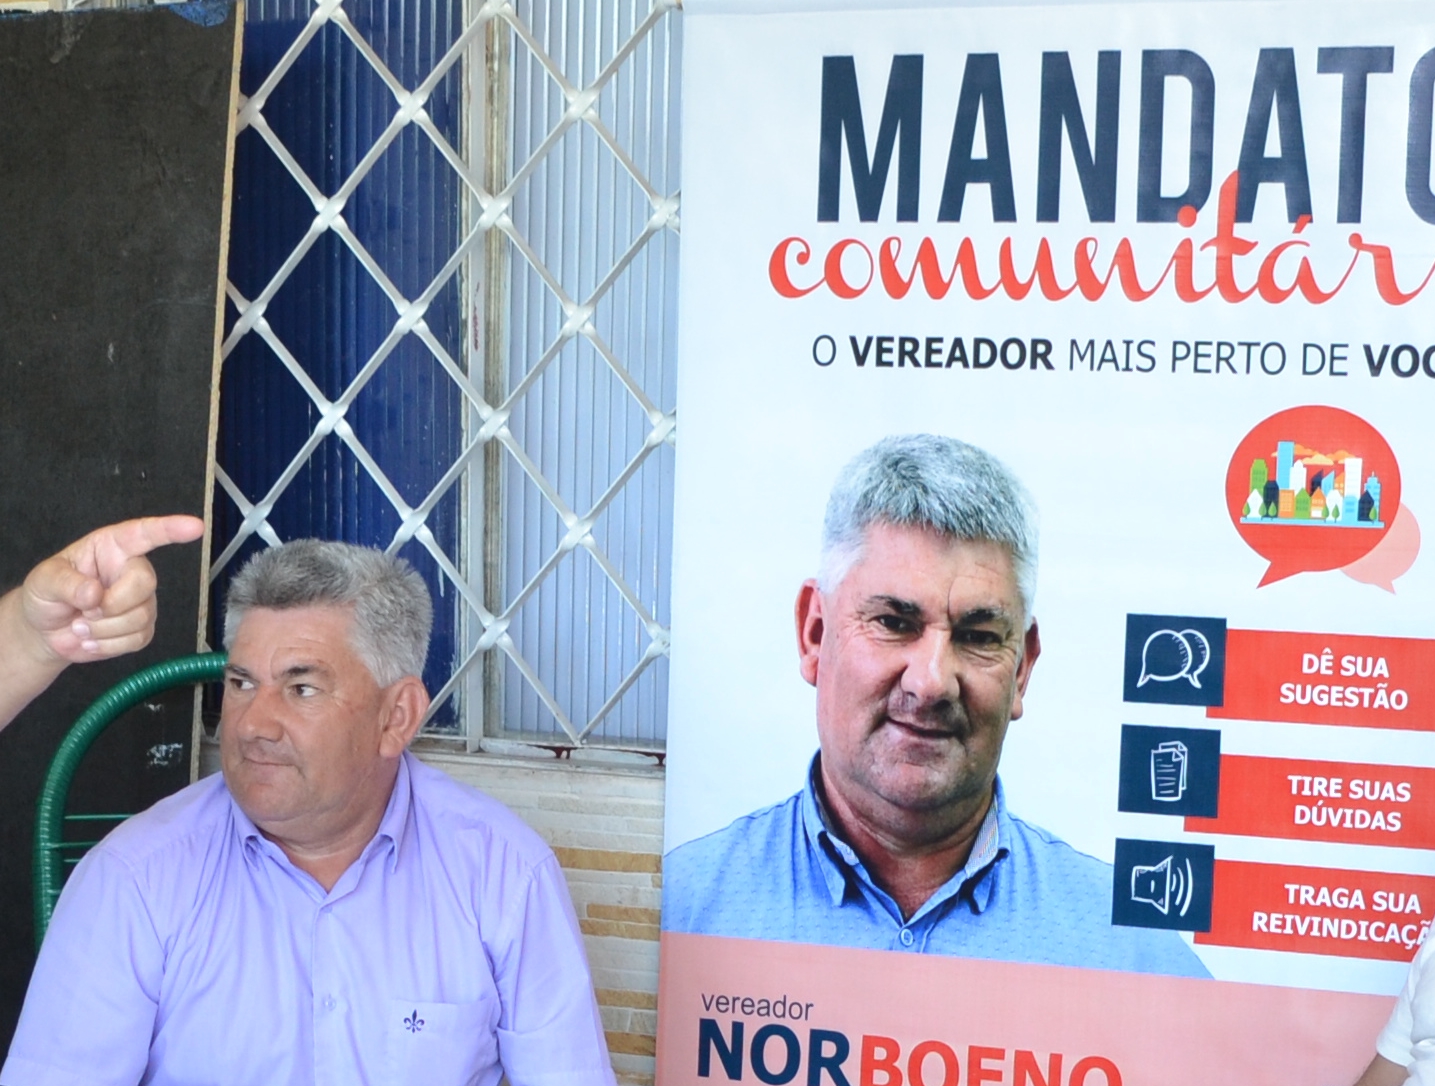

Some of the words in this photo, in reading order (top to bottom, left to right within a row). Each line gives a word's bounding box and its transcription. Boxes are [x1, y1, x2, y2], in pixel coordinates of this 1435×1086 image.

[812, 334, 837, 366] O
[849, 335, 1055, 370] VEREADOR
[1069, 338, 1156, 373] MAIS
[1171, 340, 1287, 375] PERTO
[1302, 342, 1349, 376] DE
[1301, 647, 1334, 675] DÊ
[1340, 655, 1389, 678] SUA
[1279, 682, 1409, 711] SUGESTÃO
[1287, 774, 1343, 798] TIRE
[1348, 778, 1411, 802] SUAS
[1293, 799, 1402, 831] DÚVIDAS
[1284, 883, 1365, 910] TRAGA
[1372, 890, 1422, 915] SUA
[701, 993, 814, 1021] vereador
